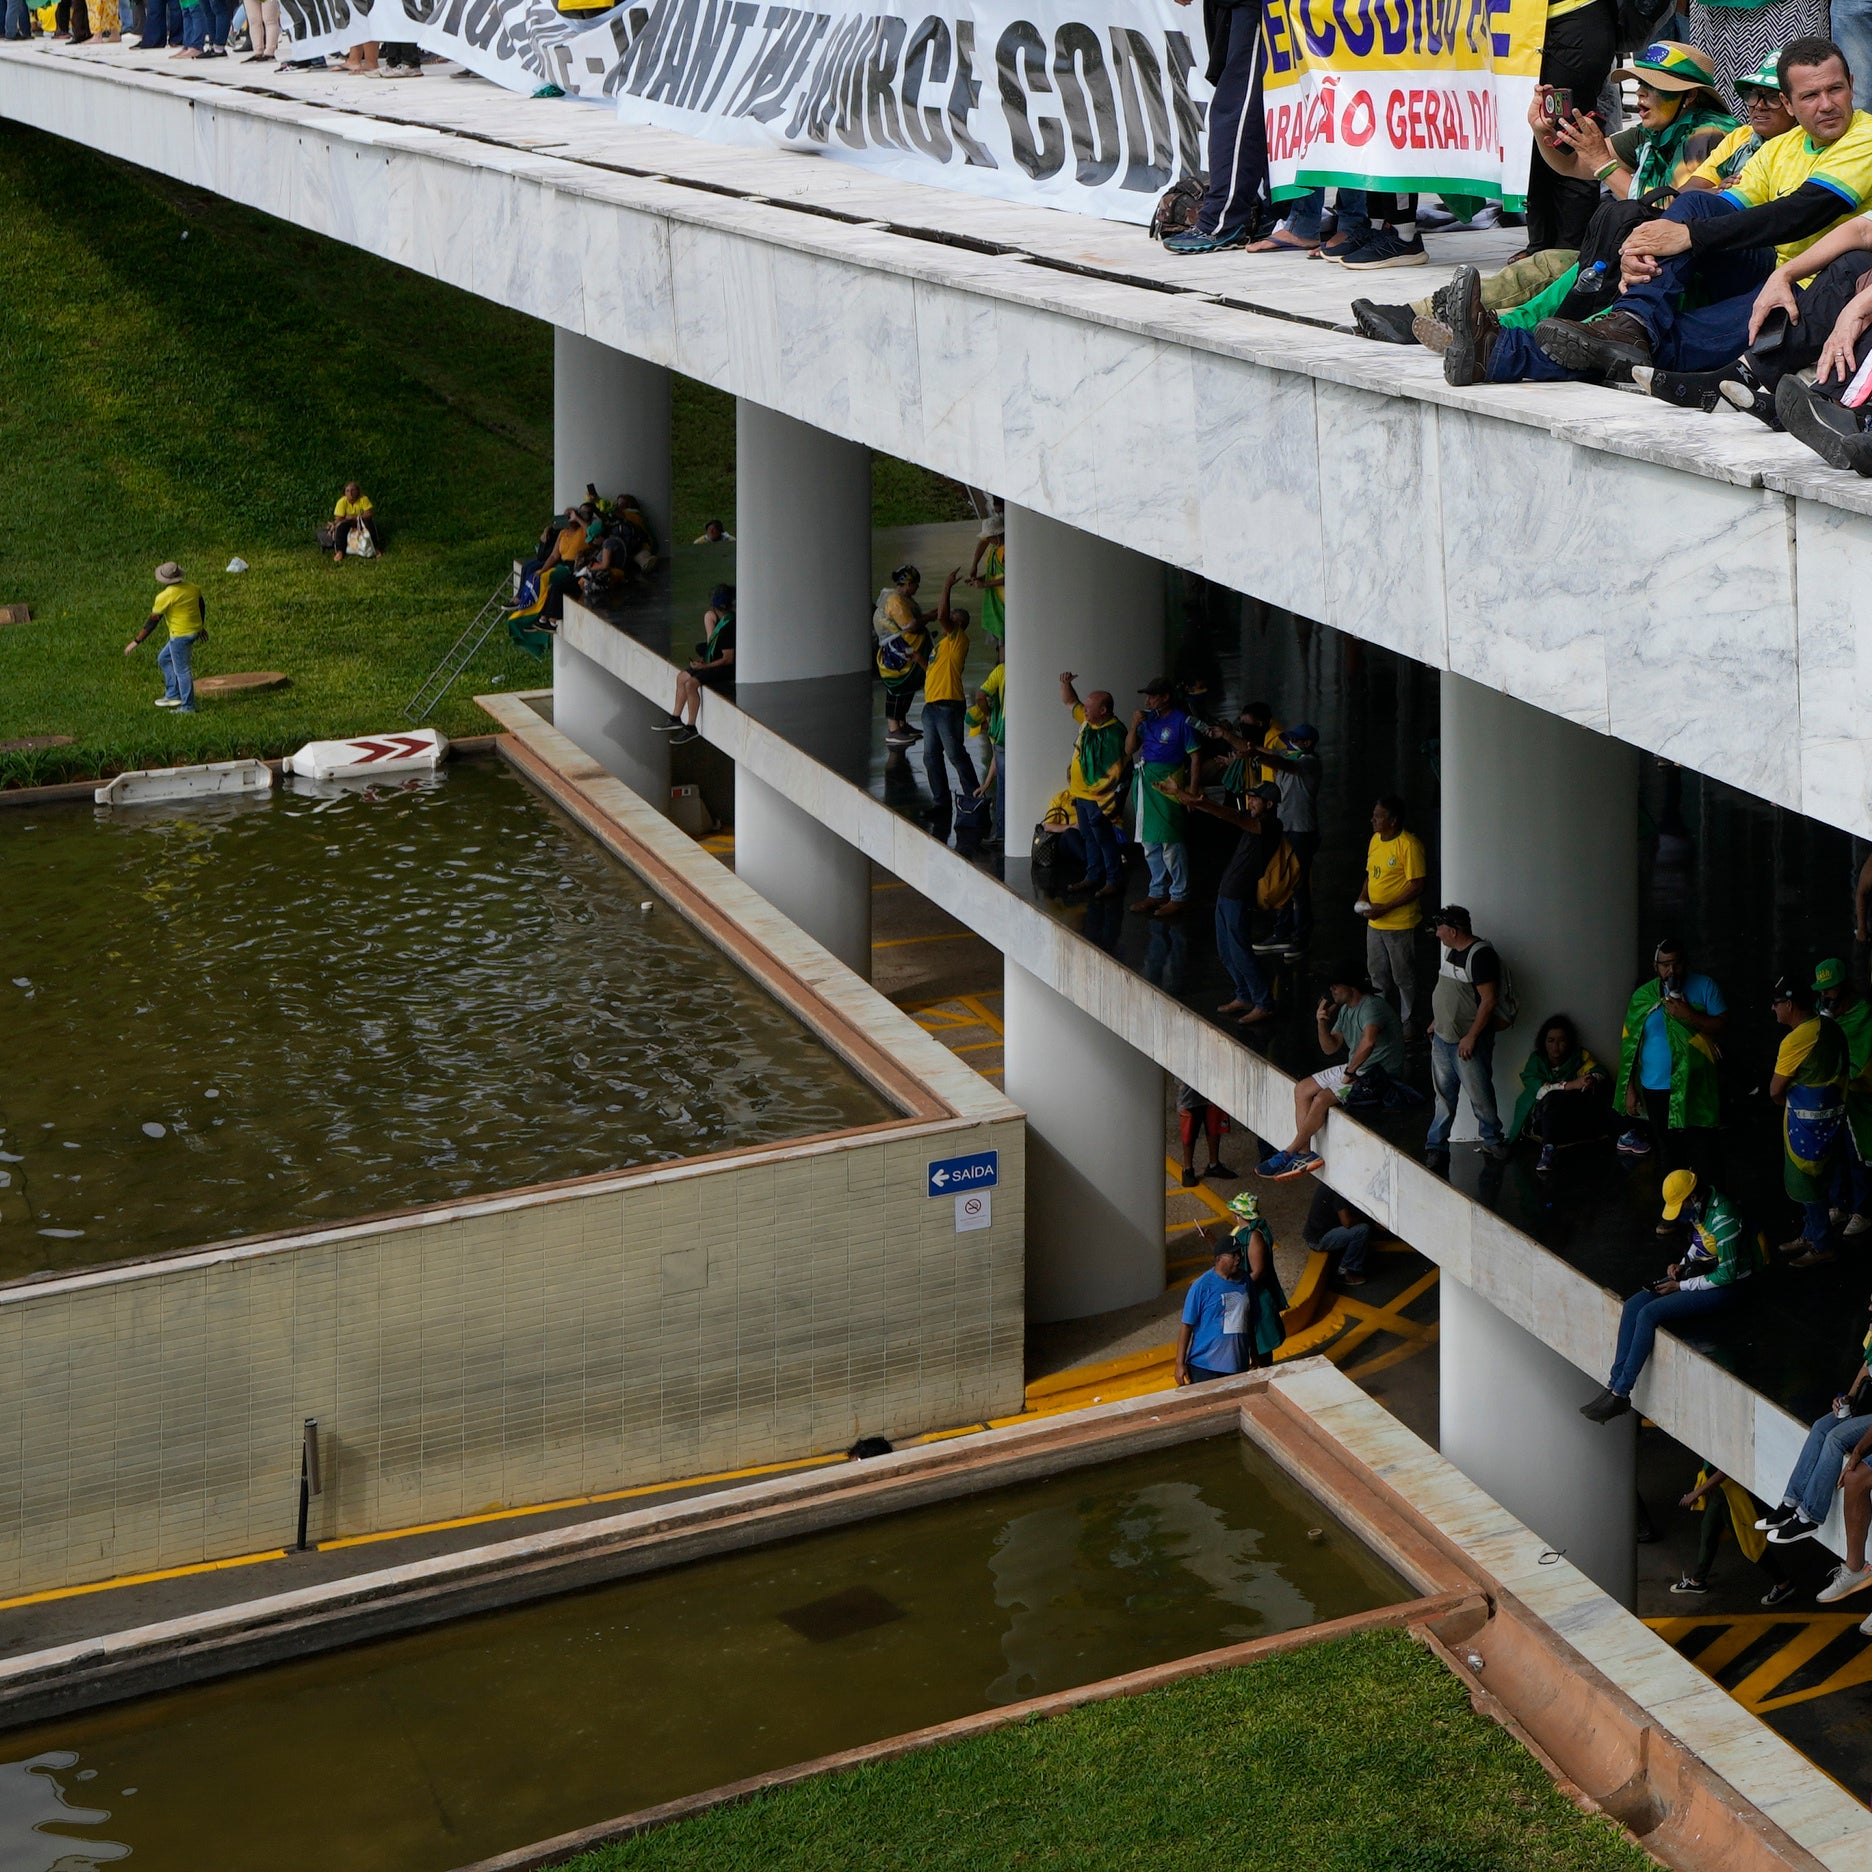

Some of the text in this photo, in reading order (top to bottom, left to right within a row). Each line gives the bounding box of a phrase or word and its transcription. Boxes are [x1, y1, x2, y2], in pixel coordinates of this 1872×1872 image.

[995, 19, 1210, 194] CODE
[1385, 88, 1469, 151] GERAL
[951, 1164, 994, 1183] SAÍDA
